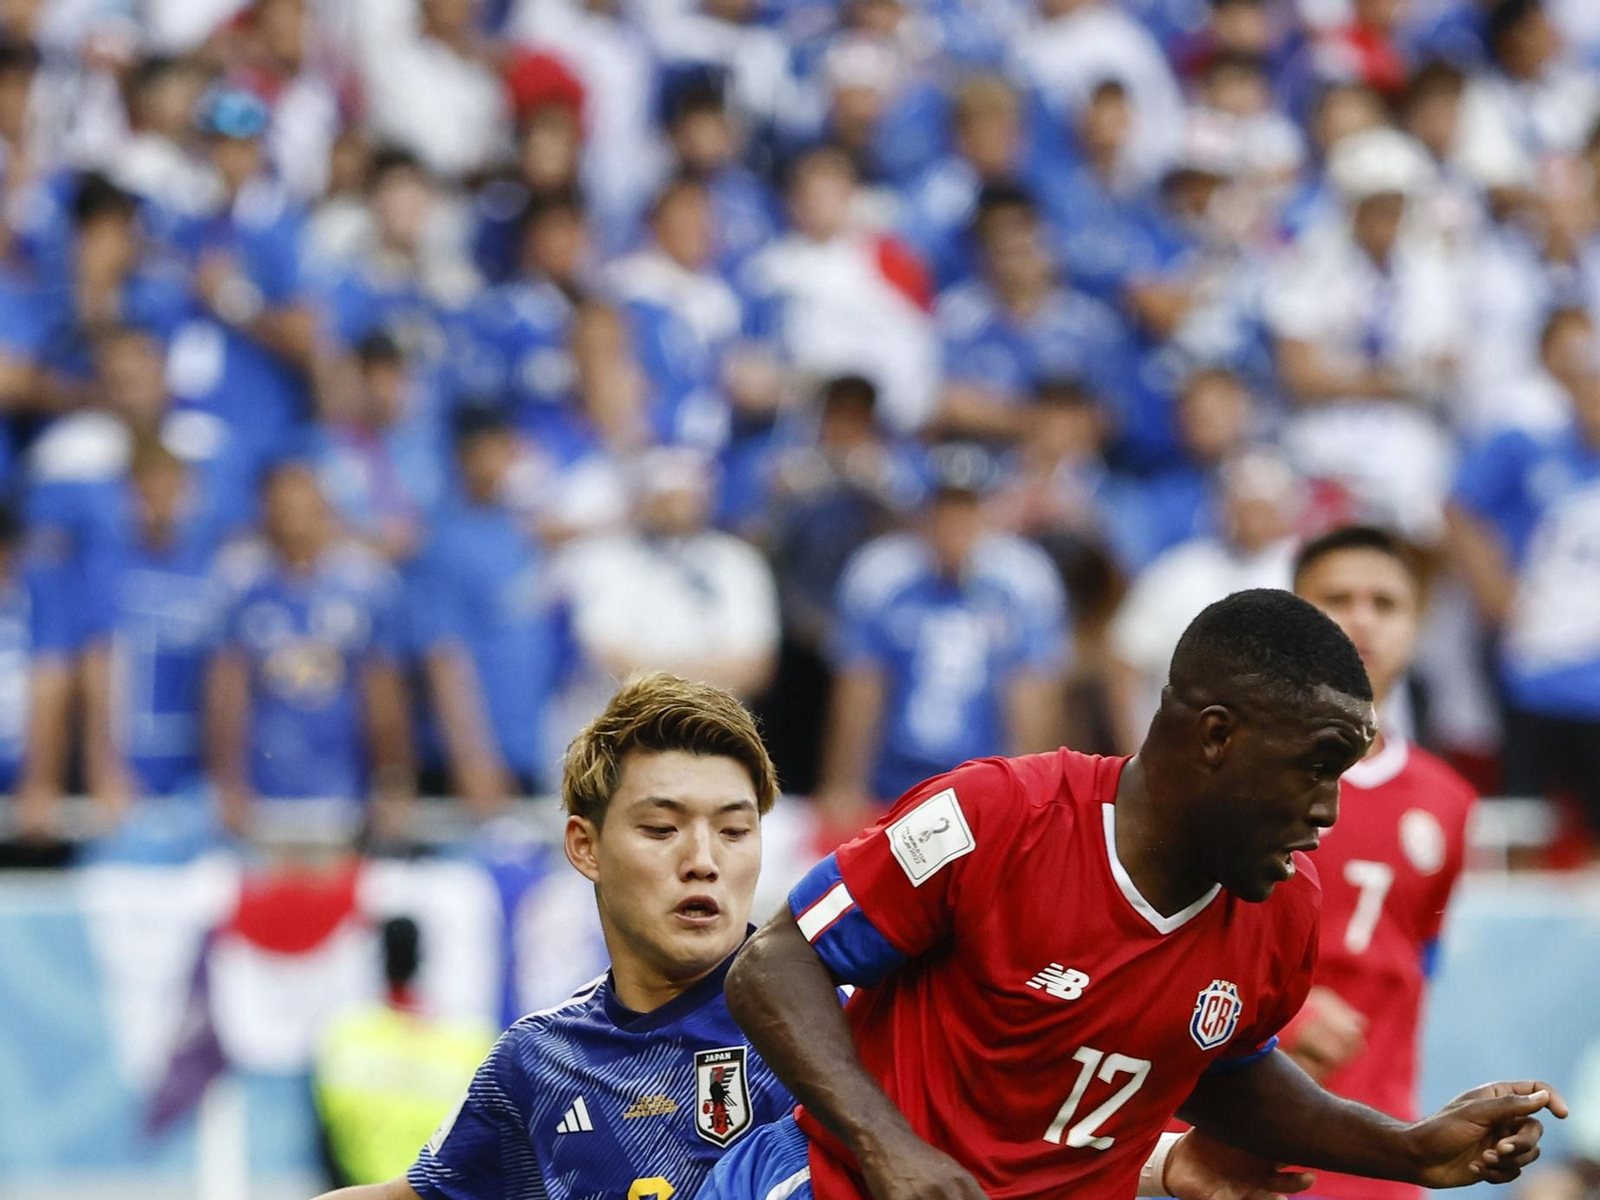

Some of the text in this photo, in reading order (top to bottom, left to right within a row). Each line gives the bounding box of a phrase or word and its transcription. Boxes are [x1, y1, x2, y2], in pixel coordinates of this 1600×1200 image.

[1343, 859, 1395, 955] 7
[1025, 963, 1090, 1001] NB
[1201, 996, 1232, 1038] CR
[704, 1052, 731, 1063] JAPAN
[1042, 1045, 1152, 1151] 12
[708, 1114, 734, 1129] JFA
